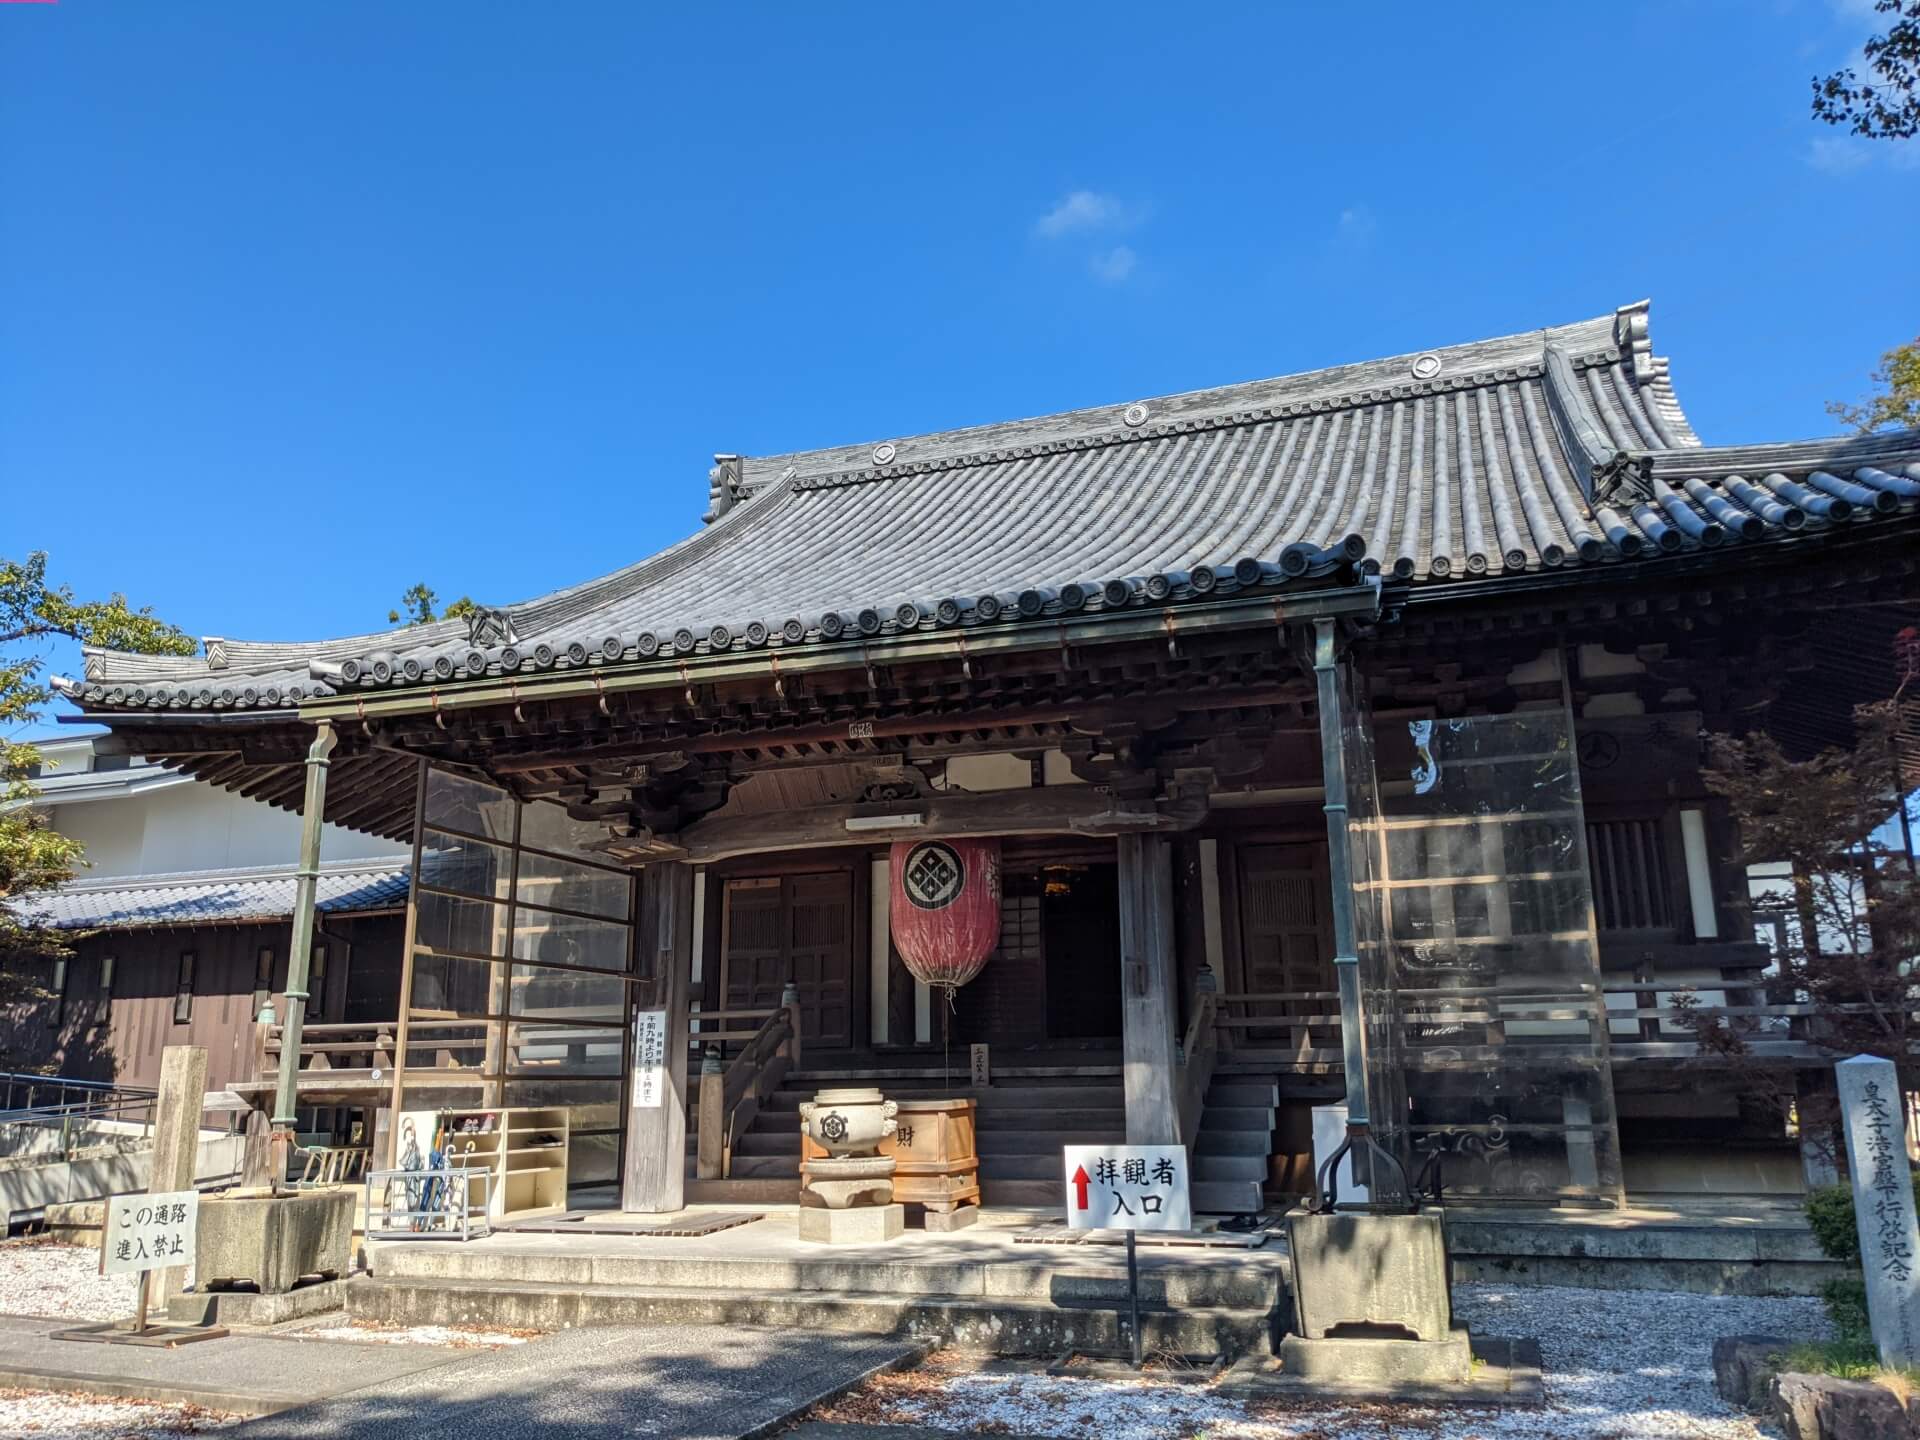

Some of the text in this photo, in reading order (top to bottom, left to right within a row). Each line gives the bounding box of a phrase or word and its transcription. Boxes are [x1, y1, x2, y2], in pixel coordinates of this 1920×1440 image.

[896, 1125, 915, 1148] 財
[1096, 1157, 1176, 1187] 拝観者
[120, 1203, 187, 1228] この通路
[1112, 1191, 1164, 1216] 入口
[115, 1233, 185, 1261] 進入禁止
